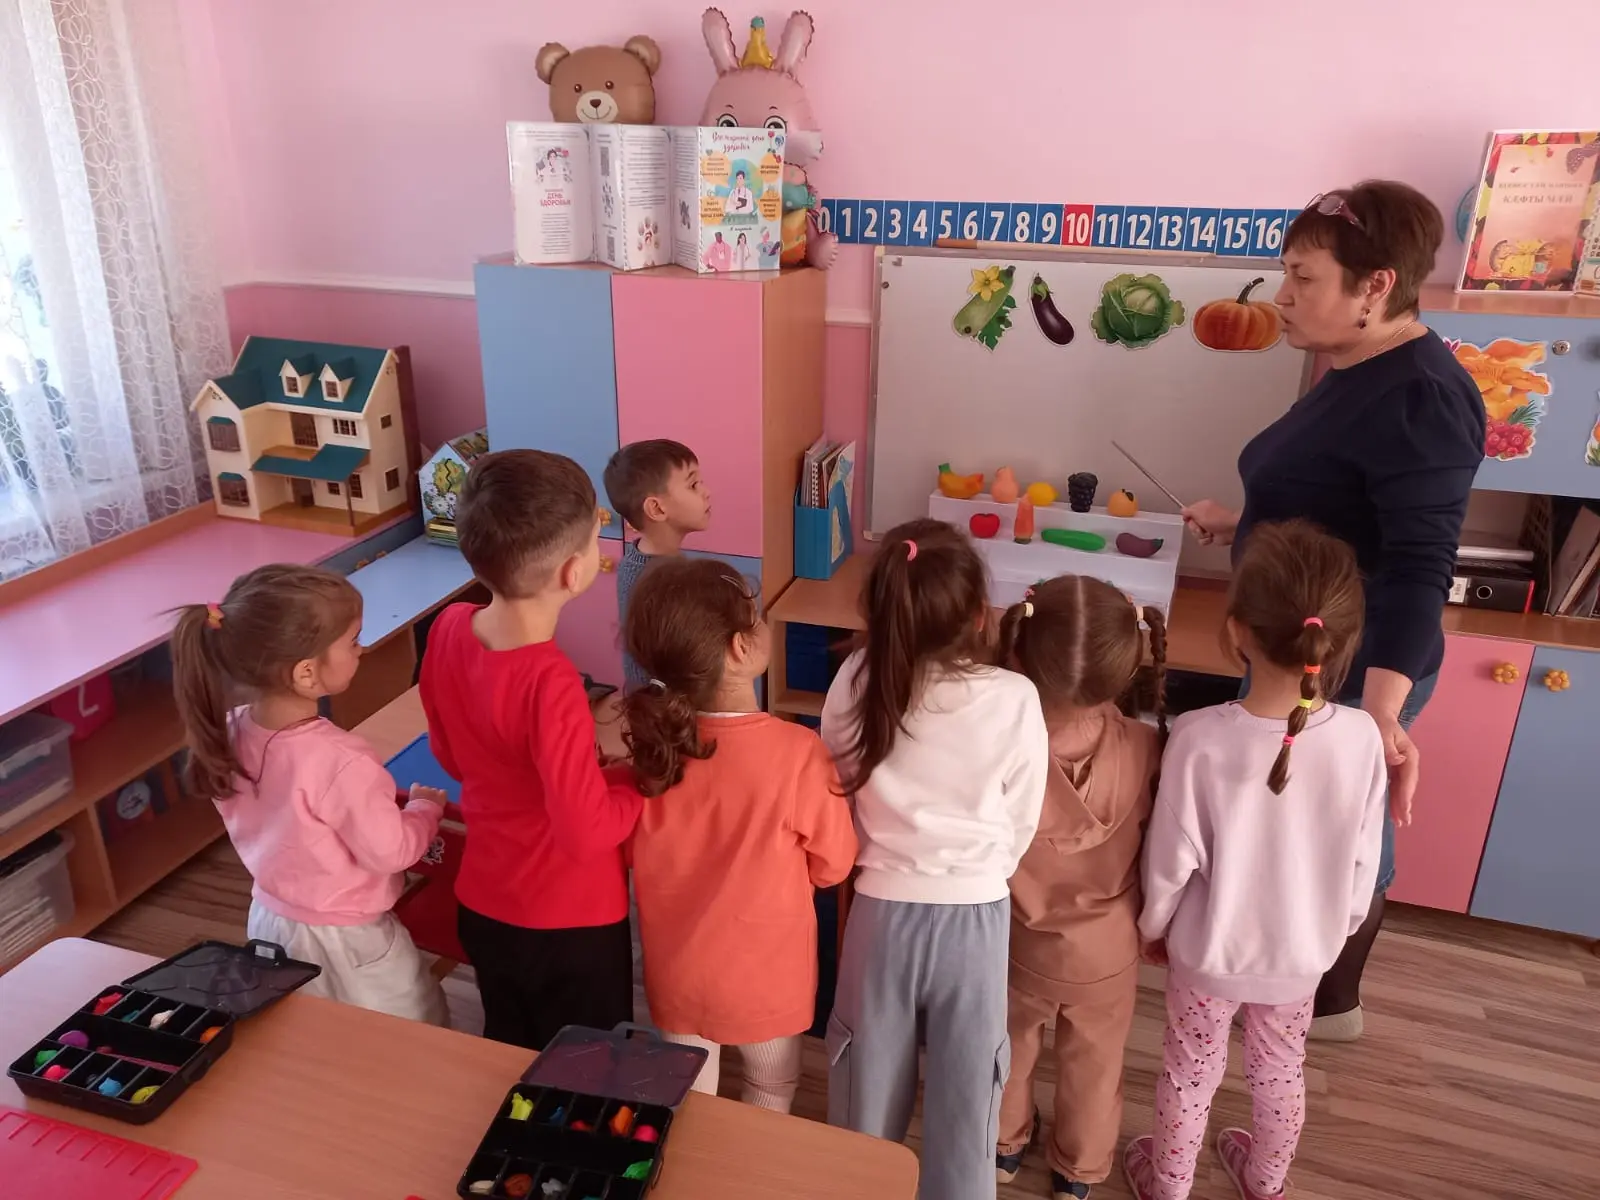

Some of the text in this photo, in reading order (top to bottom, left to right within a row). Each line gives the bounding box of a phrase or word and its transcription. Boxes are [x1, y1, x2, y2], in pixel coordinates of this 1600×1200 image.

[817, 206, 1283, 250] 0 1 2 3 4 5 6 7 8 9 10 11 12 13 14 15 16
